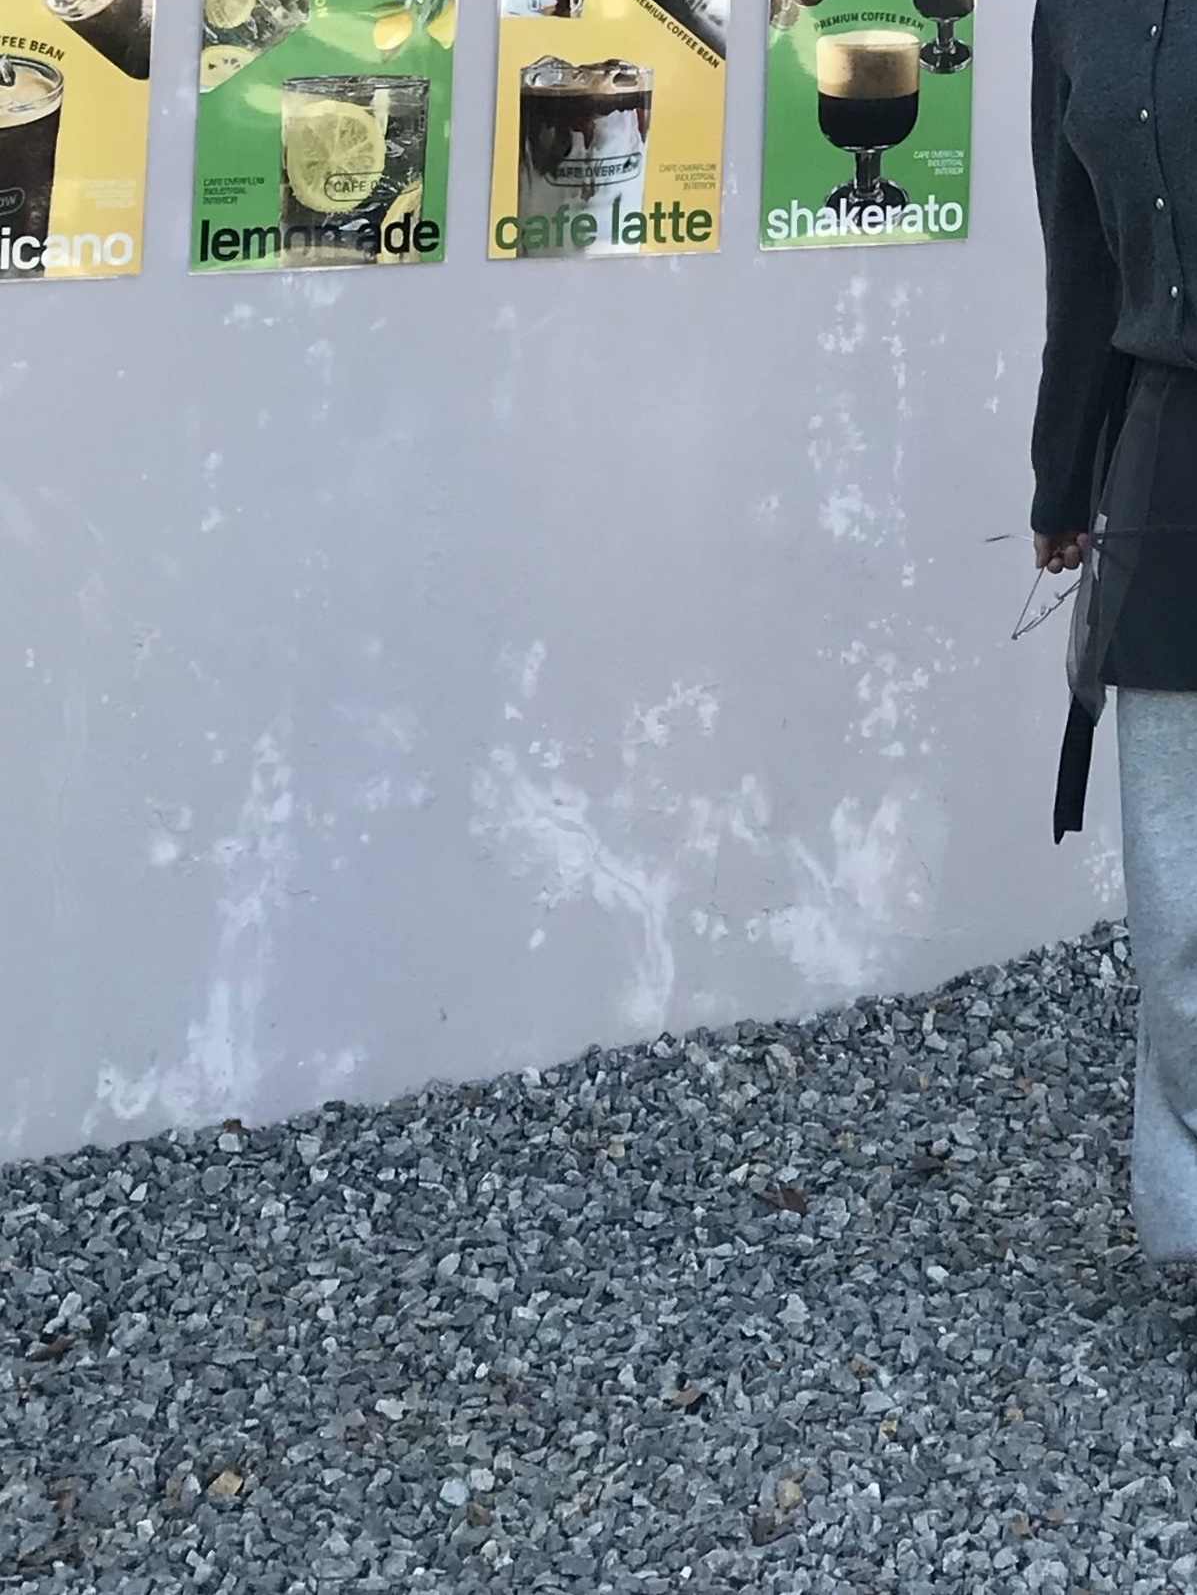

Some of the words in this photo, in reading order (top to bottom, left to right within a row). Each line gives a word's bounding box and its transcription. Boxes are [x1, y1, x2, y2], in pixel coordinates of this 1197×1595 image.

[814, 11, 859, 32] PREMIUM
[861, 11, 897, 23] COFFEE
[898, 15, 925, 31] BEAN
[0, 35, 27, 49] FEE
[29, 40, 65, 62] BEAN
[666, 20, 698, 51] COFFEE
[698, 45, 720, 69] BEAN
[333, 180, 367, 193] CAFE
[495, 204, 598, 251] cafe
[610, 198, 713, 245] latte
[767, 194, 964, 240] shakerato
[0, 226, 134, 270] icano
